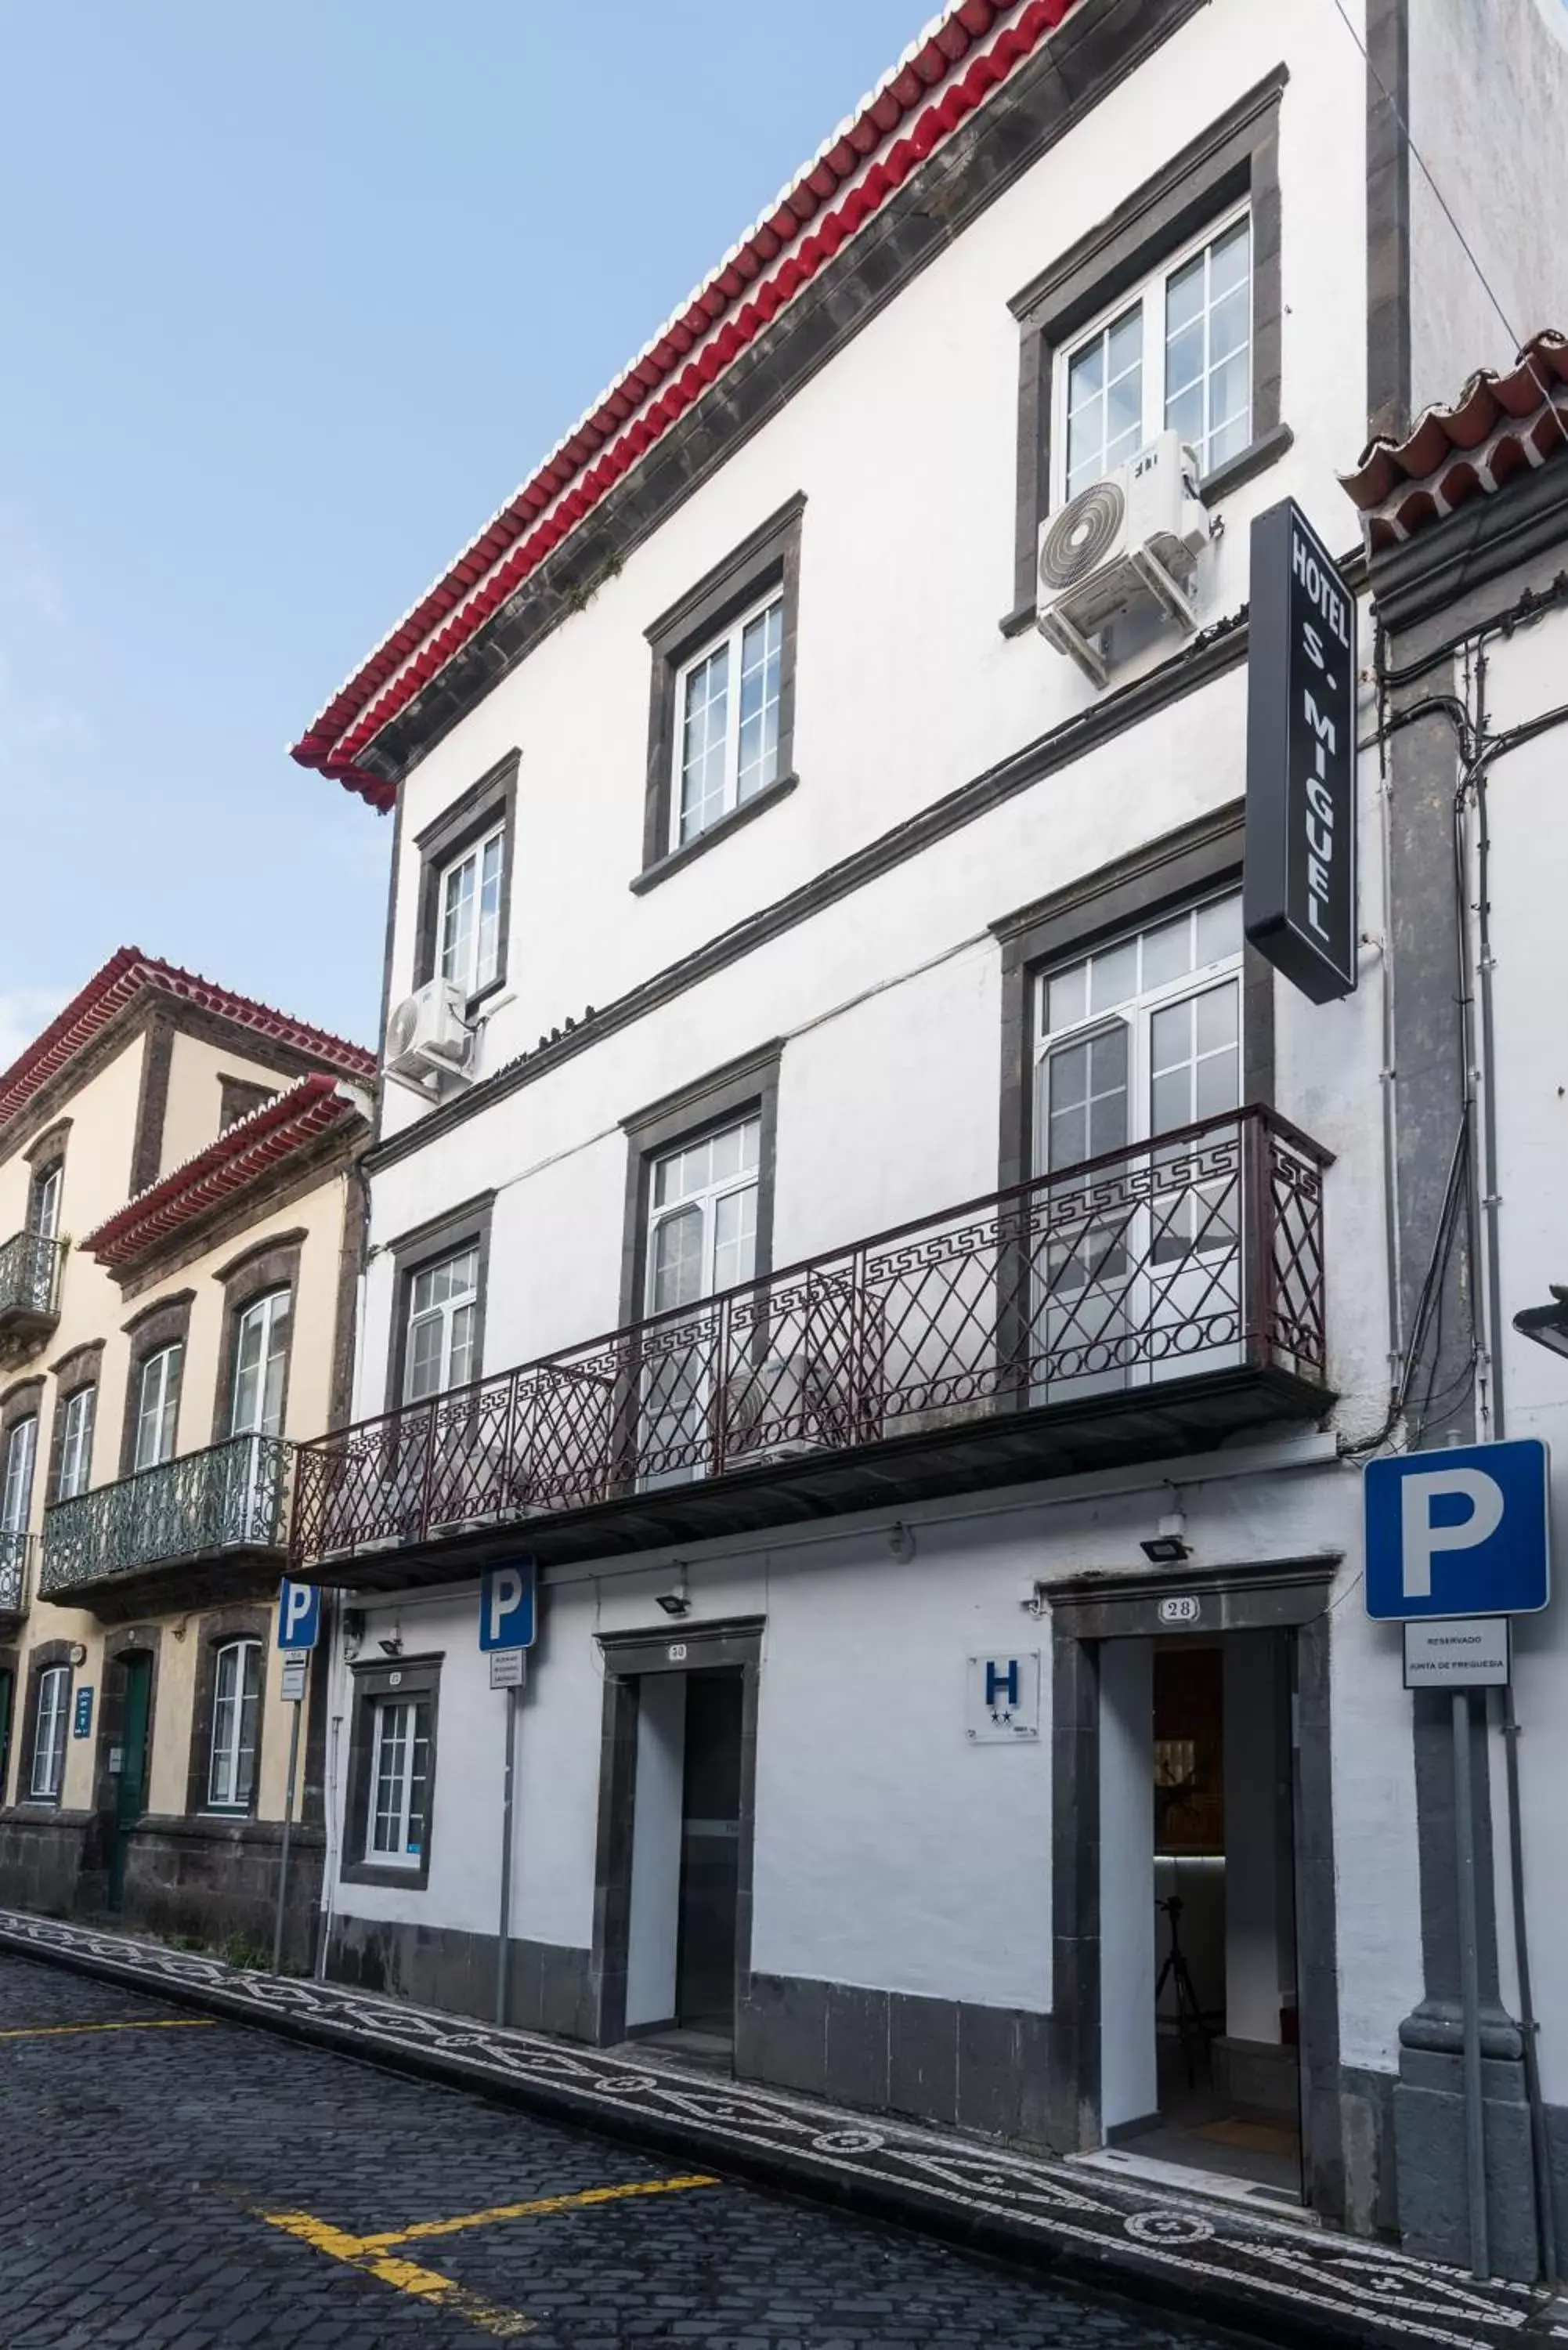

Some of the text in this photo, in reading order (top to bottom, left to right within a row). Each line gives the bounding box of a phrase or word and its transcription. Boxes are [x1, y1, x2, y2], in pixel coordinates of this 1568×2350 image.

[1293, 530, 1349, 649] HOTEL
[1304, 689, 1335, 941] MIGUEL
[1402, 1467, 1505, 1597] P
[286, 1582, 311, 1640] P
[490, 1568, 522, 1640] P
[1168, 1601, 1190, 1616] 28
[1410, 1660, 1504, 1671] JUNTA DE FREGUESIA
[1427, 1636, 1482, 1646] RESERVADO
[986, 1660, 1017, 1705] H
